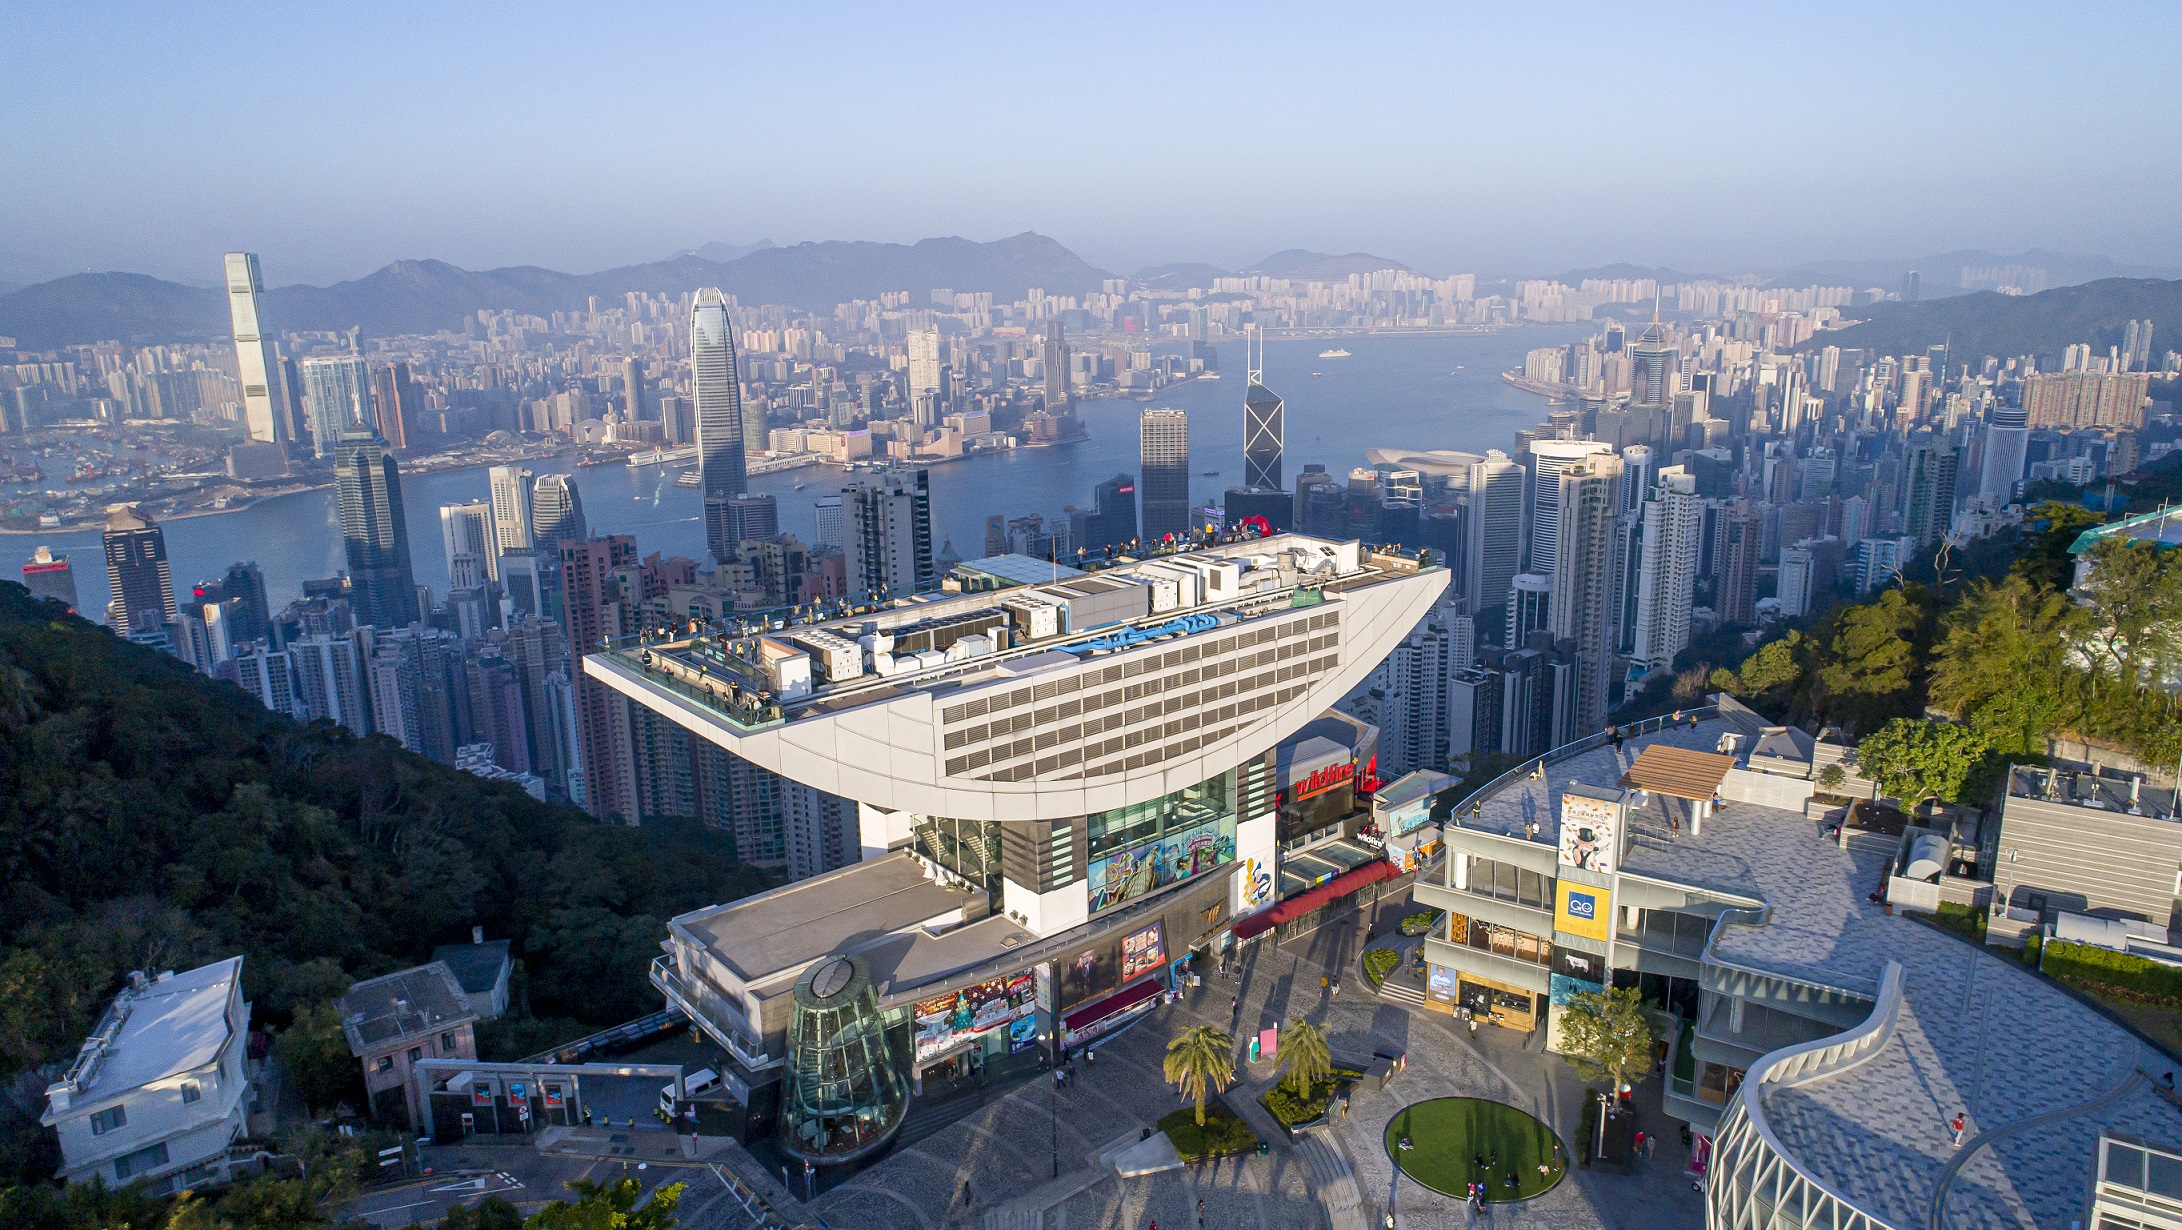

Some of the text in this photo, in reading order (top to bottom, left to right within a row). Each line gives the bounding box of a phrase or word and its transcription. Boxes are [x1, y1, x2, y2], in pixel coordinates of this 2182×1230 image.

[1296, 763, 1354, 795] wildfire
[1357, 833, 1383, 848] wildfire
[1571, 900, 1592, 913] GO
